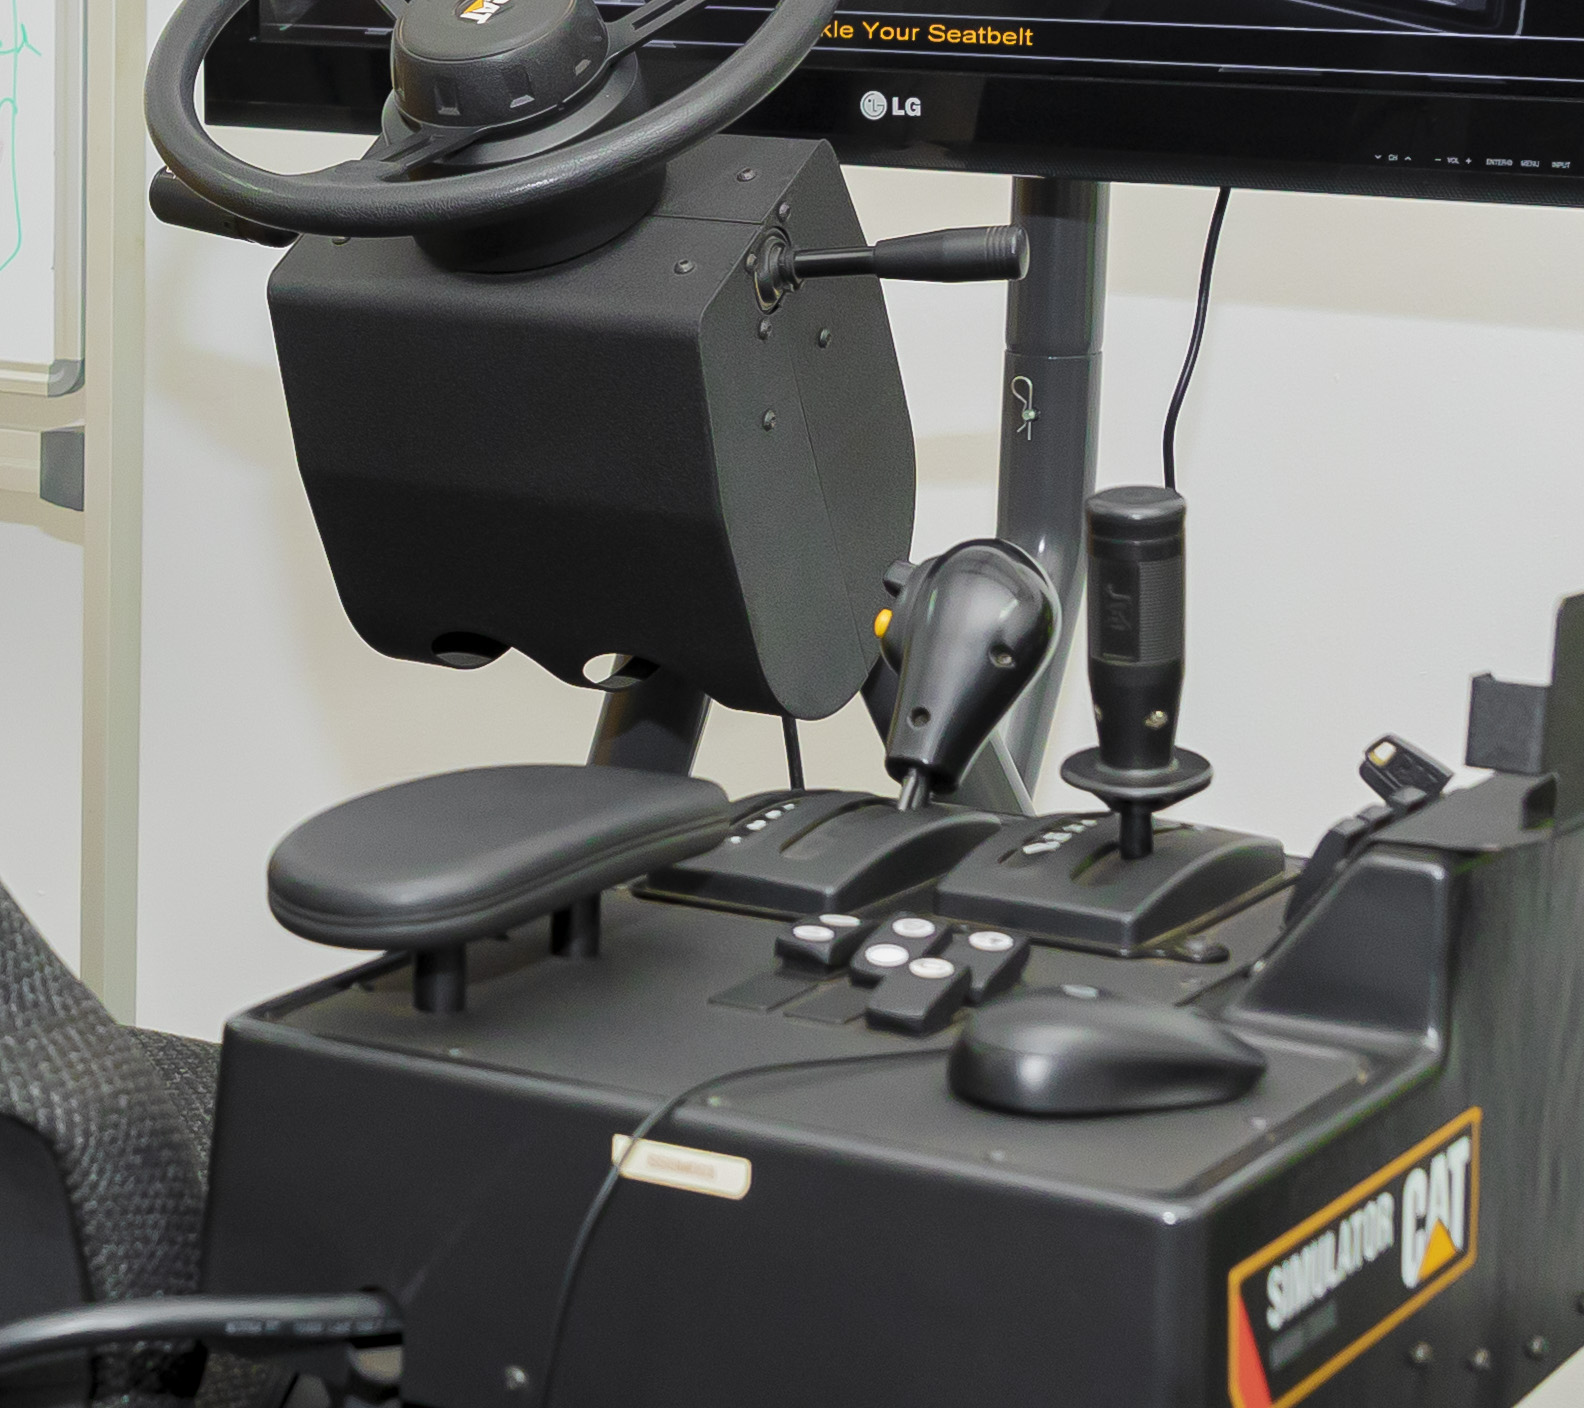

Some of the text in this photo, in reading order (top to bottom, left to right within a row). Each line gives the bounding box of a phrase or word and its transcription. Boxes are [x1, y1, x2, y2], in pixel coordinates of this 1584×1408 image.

[862, 20, 920, 42] Your
[927, 23, 1034, 47] Seatbelt
[891, 96, 922, 117] LG
[1400, 1135, 1471, 1289] CAT
[1266, 1191, 1396, 1331] SIMULATOR
